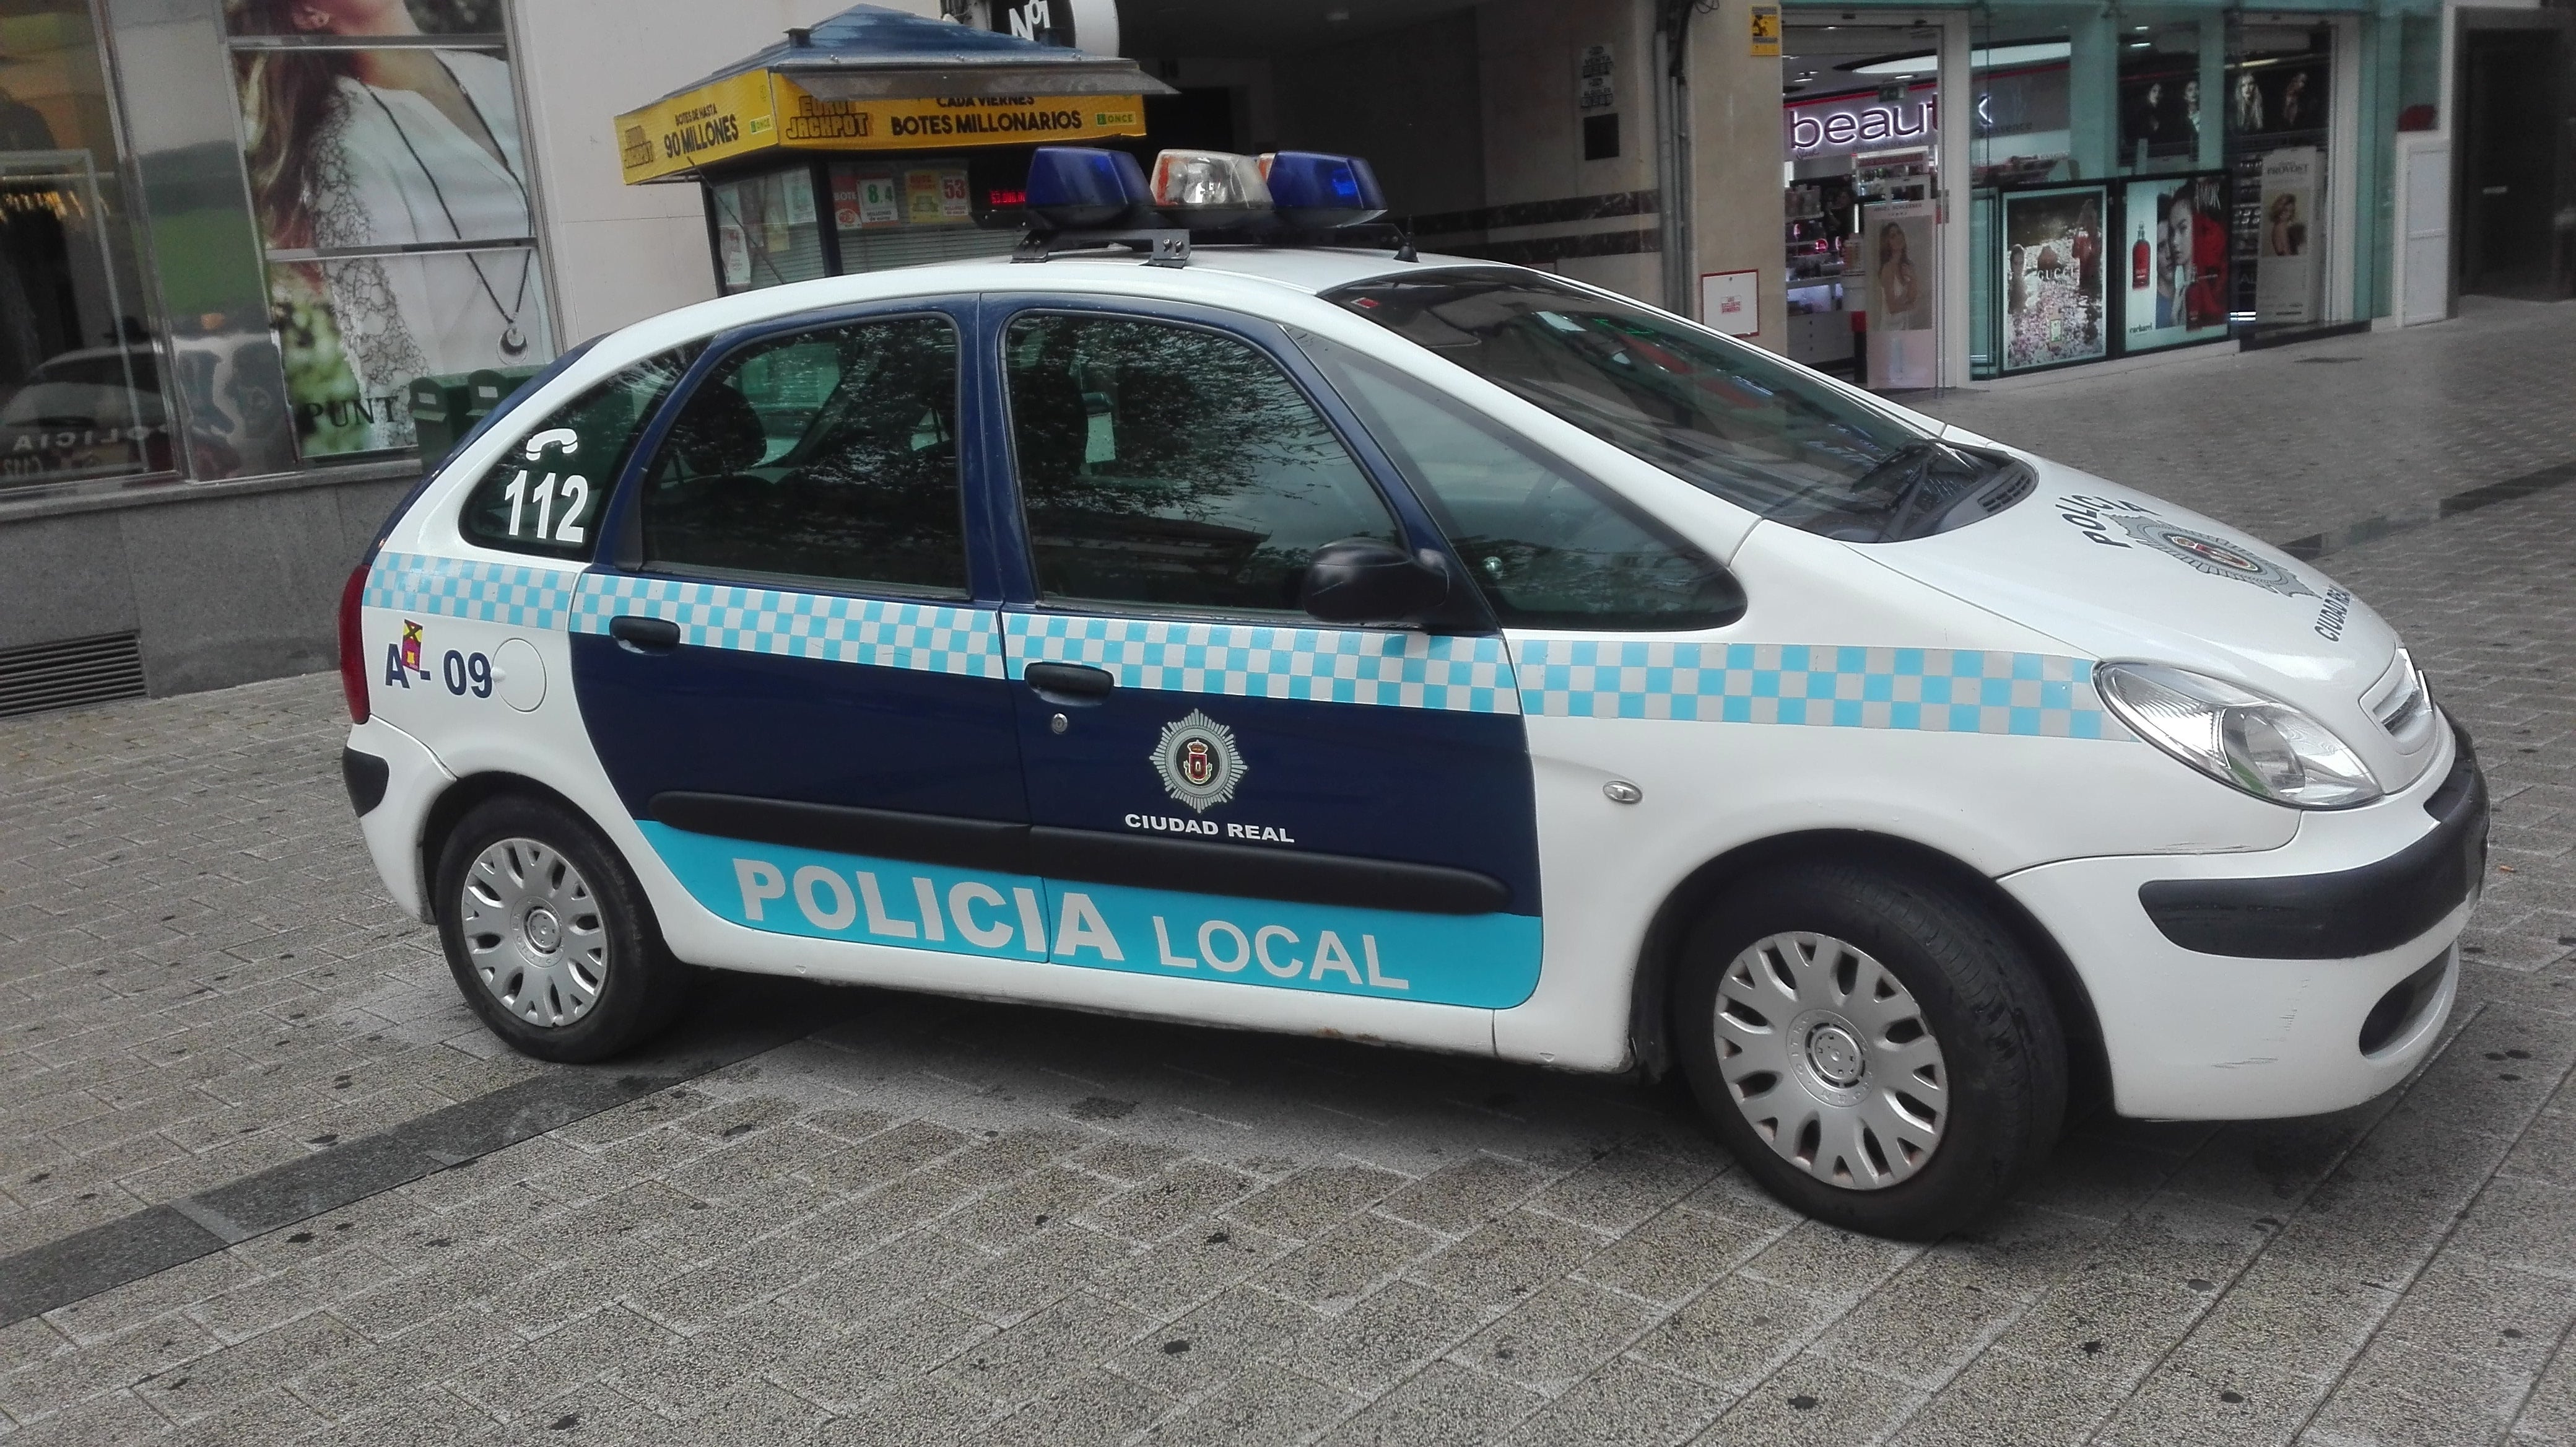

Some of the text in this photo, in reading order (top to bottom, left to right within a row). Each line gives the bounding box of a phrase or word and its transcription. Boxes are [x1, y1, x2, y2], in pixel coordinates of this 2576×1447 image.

[664, 131, 681, 159] 90
[680, 113, 739, 155] MILLONES
[786, 112, 869, 140] JACKPOT
[890, 110, 1083, 136] BOTES MILLONARIOS
[1107, 113, 1134, 123] ONCE
[943, 178, 966, 199] 53
[2037, 266, 2074, 281] GUCCI
[505, 470, 588, 543] 112
[2055, 494, 2162, 549] POLICIA
[2315, 598, 2348, 642] CIUDAD
[443, 649, 493, 699] 09
[1125, 813, 1295, 843] CIUDAD REAL
[733, 858, 1125, 961] POLICIA
[1152, 916, 1409, 990] LOCAL
